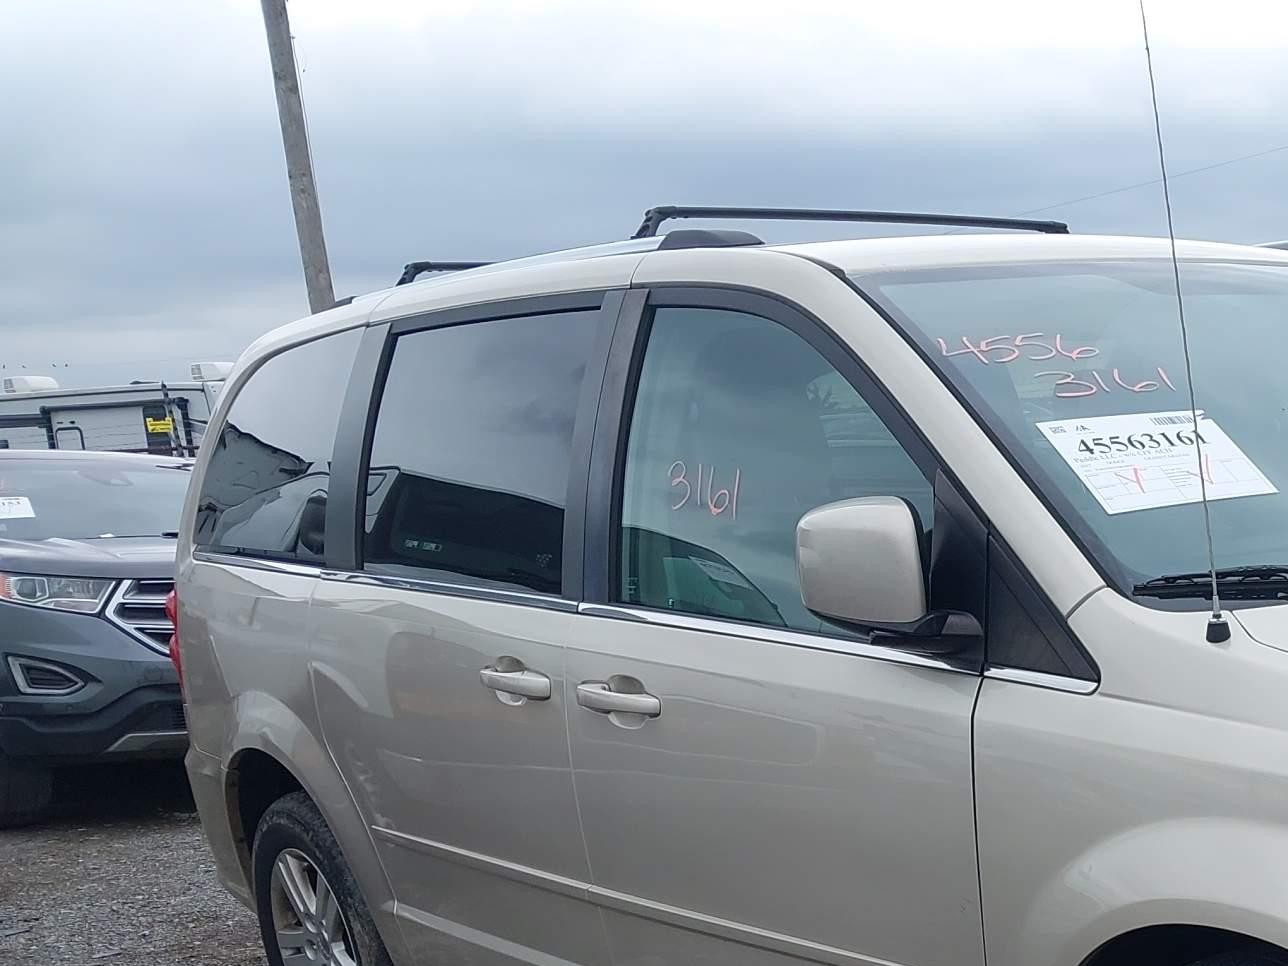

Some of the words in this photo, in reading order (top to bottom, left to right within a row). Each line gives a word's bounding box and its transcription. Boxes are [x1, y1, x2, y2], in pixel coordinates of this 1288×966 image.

[936, 333, 1100, 364] 4556
[1034, 367, 1176, 398] 3161
[1078, 430, 1209, 455] 45563161
[667, 460, 744, 520] 3161
